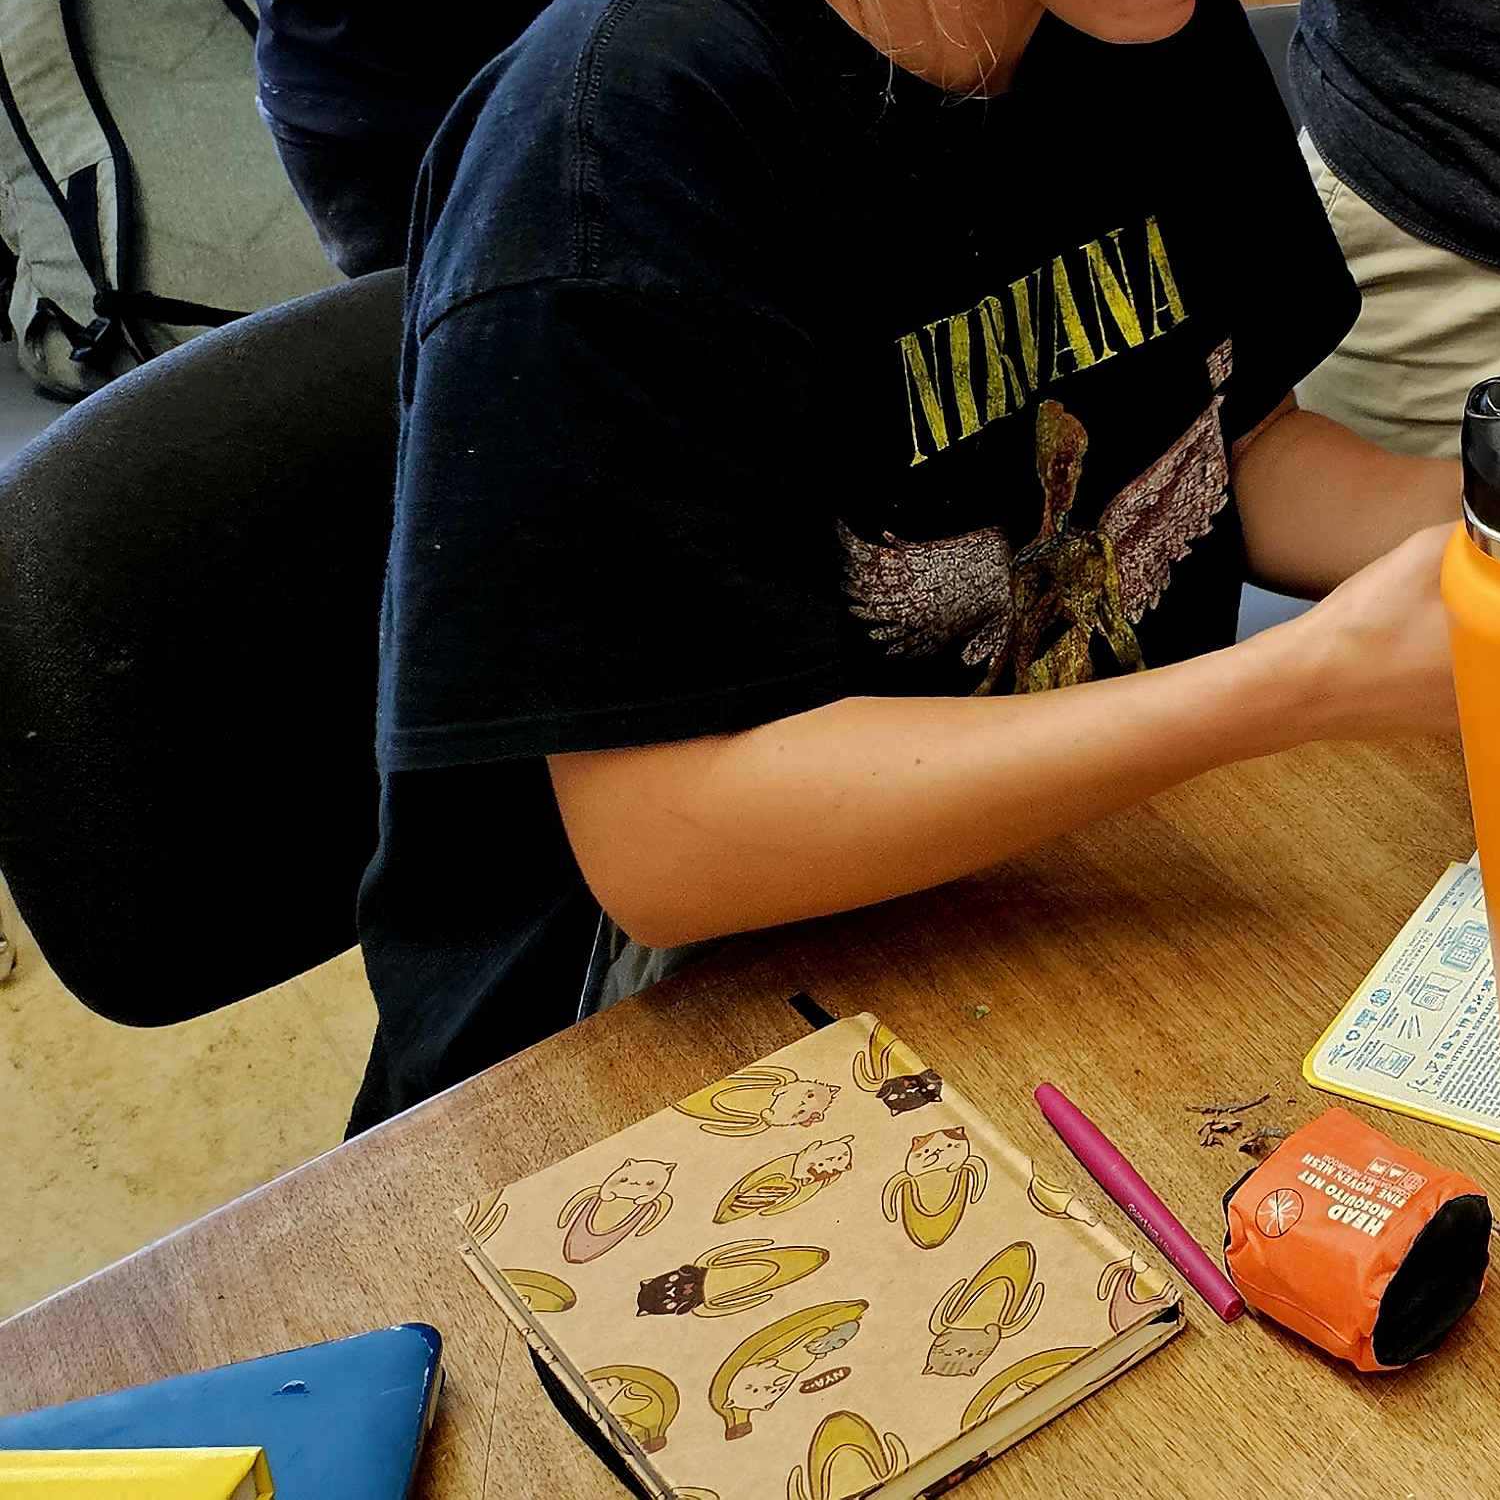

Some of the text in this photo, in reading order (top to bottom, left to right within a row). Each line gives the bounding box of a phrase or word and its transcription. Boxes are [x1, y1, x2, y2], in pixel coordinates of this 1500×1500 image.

[895, 214, 1190, 467] NIRVANA
[1434, 996, 1498, 1086] USTRIES WORLD-WIDE
[1301, 1152, 1408, 1209] FINE WOVEN MESH
[1322, 1153, 1362, 1178] HEADROOM
[1297, 1170, 1394, 1221] MOSQUITO NET
[1327, 1204, 1386, 1237] HEAD
